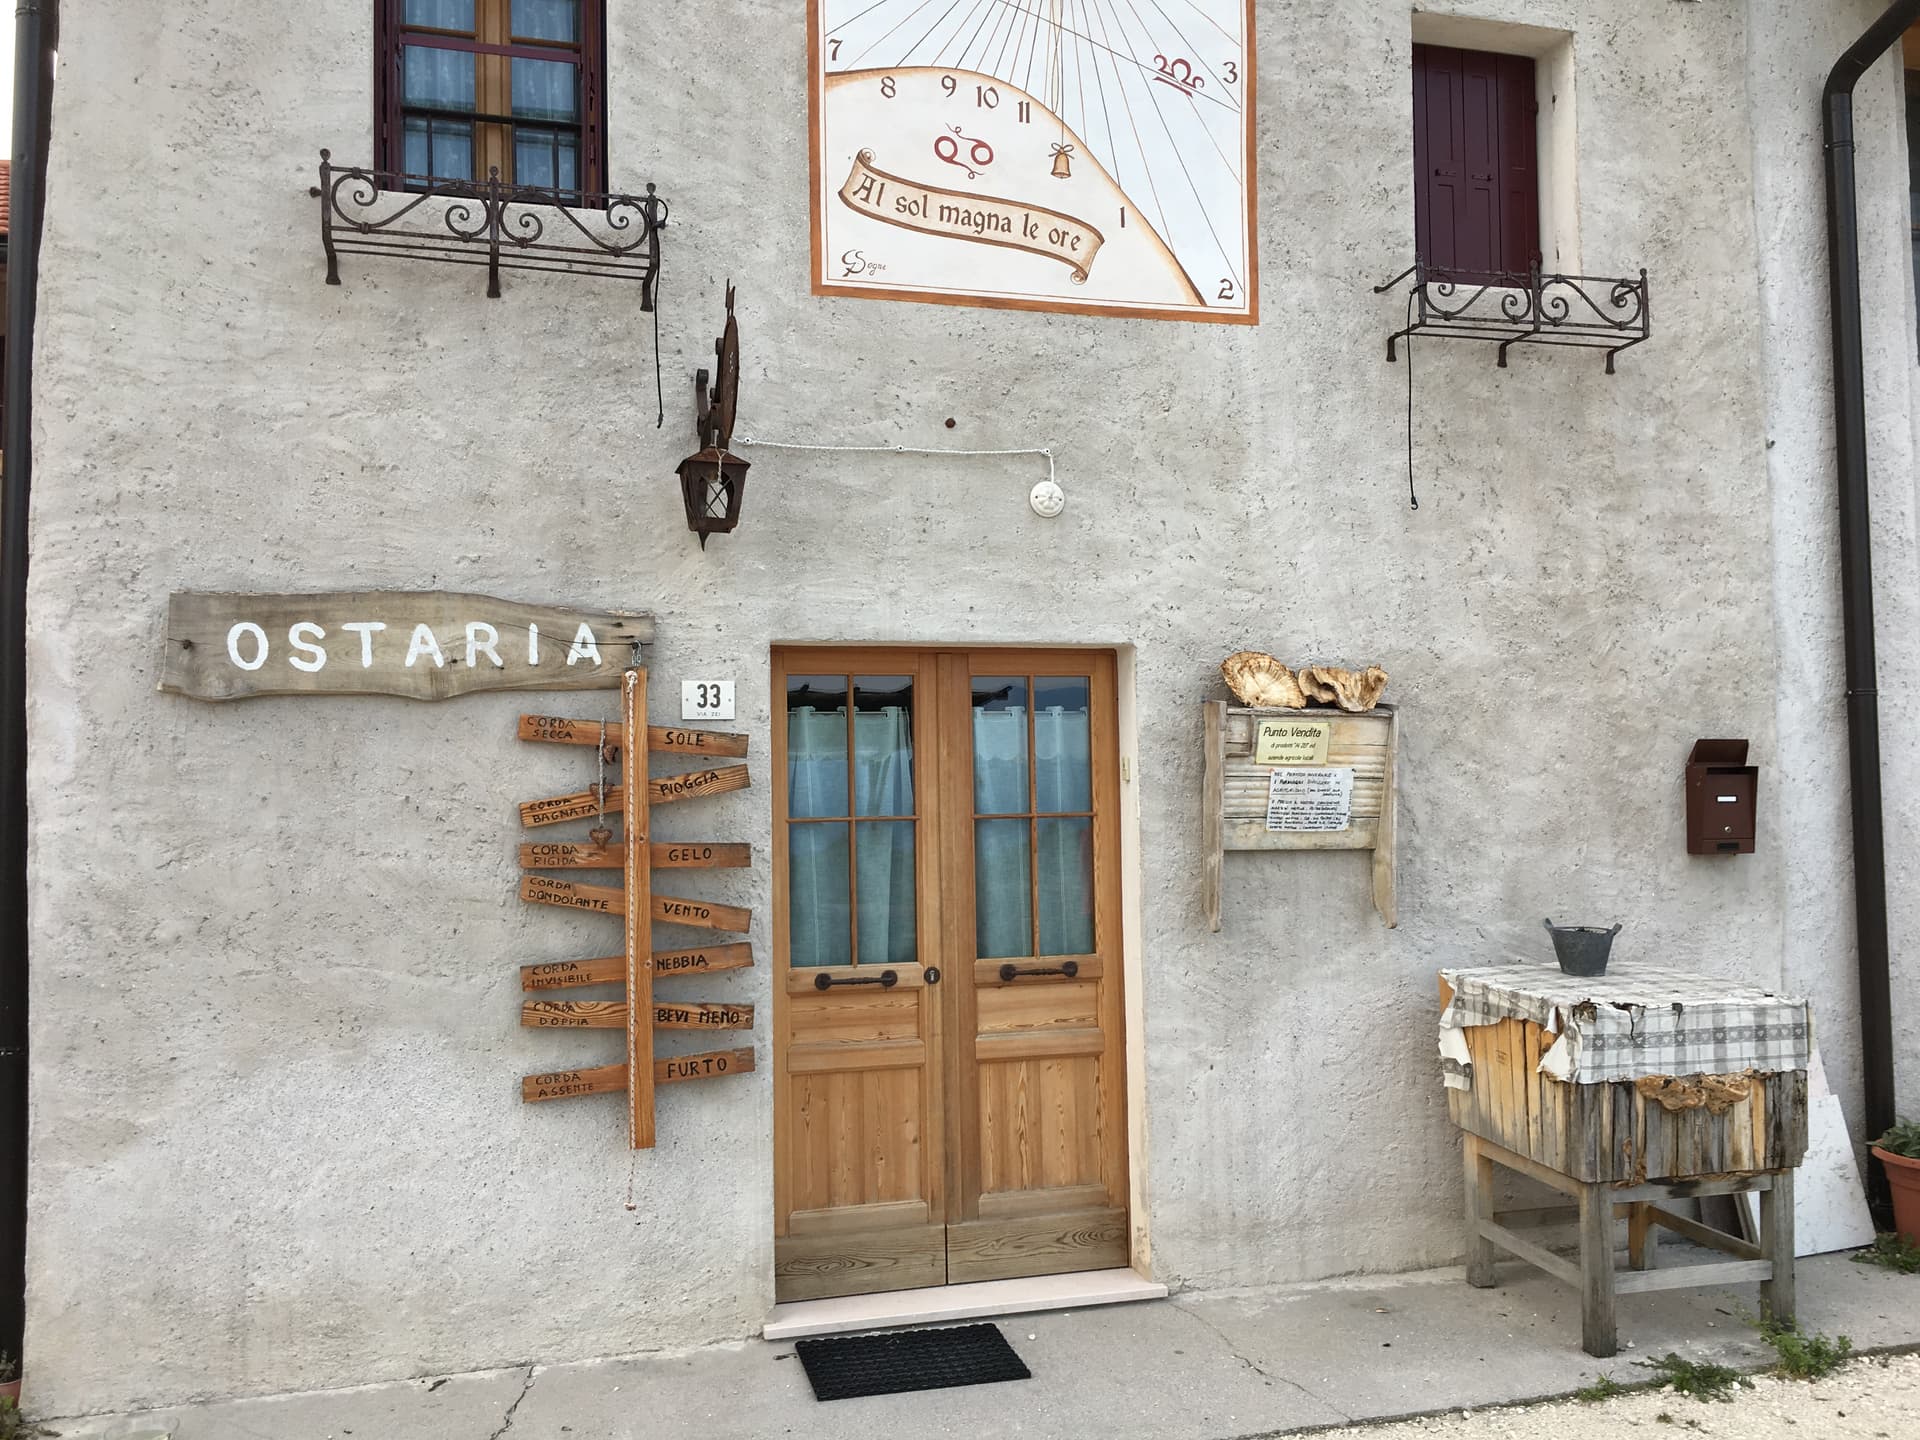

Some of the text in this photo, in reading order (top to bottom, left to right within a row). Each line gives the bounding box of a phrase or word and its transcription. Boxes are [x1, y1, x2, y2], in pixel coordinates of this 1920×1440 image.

[828, 38, 843, 62] 7
[1222, 61, 1238, 84] 3
[880, 76, 897, 99] 8
[941, 75, 957, 98] 9
[976, 85, 999, 109] 10
[1017, 101, 1031, 124] 11
[852, 172, 1081, 252] Al sol magna le ore
[1119, 206, 1127, 229] 1
[1218, 278, 1235, 300] 2
[226, 621, 603, 672] OSTARIA
[697, 683, 721, 709] 33
[527, 715, 577, 729] CORDA
[532, 730, 573, 739] SECCA
[664, 731, 705, 747] SOLE
[1263, 727, 1322, 738] Punto Vendita
[660, 771, 719, 796] PIOGGIA
[529, 798, 572, 811] CORDA
[532, 803, 598, 824] BAGNATA
[531, 845, 579, 855] CORDA
[669, 847, 712, 862] GELO
[530, 877, 572, 890] CORDA
[528, 889, 609, 910] DONDOLANTE
[664, 901, 710, 919] VENTO
[532, 963, 578, 974] CORDA
[657, 954, 709, 971] NEBBIA
[531, 974, 593, 986] INVISIBILE
[534, 1002, 575, 1013] CORDA
[539, 1017, 589, 1026] DOPPIA
[657, 1009, 740, 1025] BEVI MENO
[667, 1057, 727, 1078] FURTO
[535, 1073, 581, 1086] CORDA
[538, 1083, 594, 1098] ASSENTE
